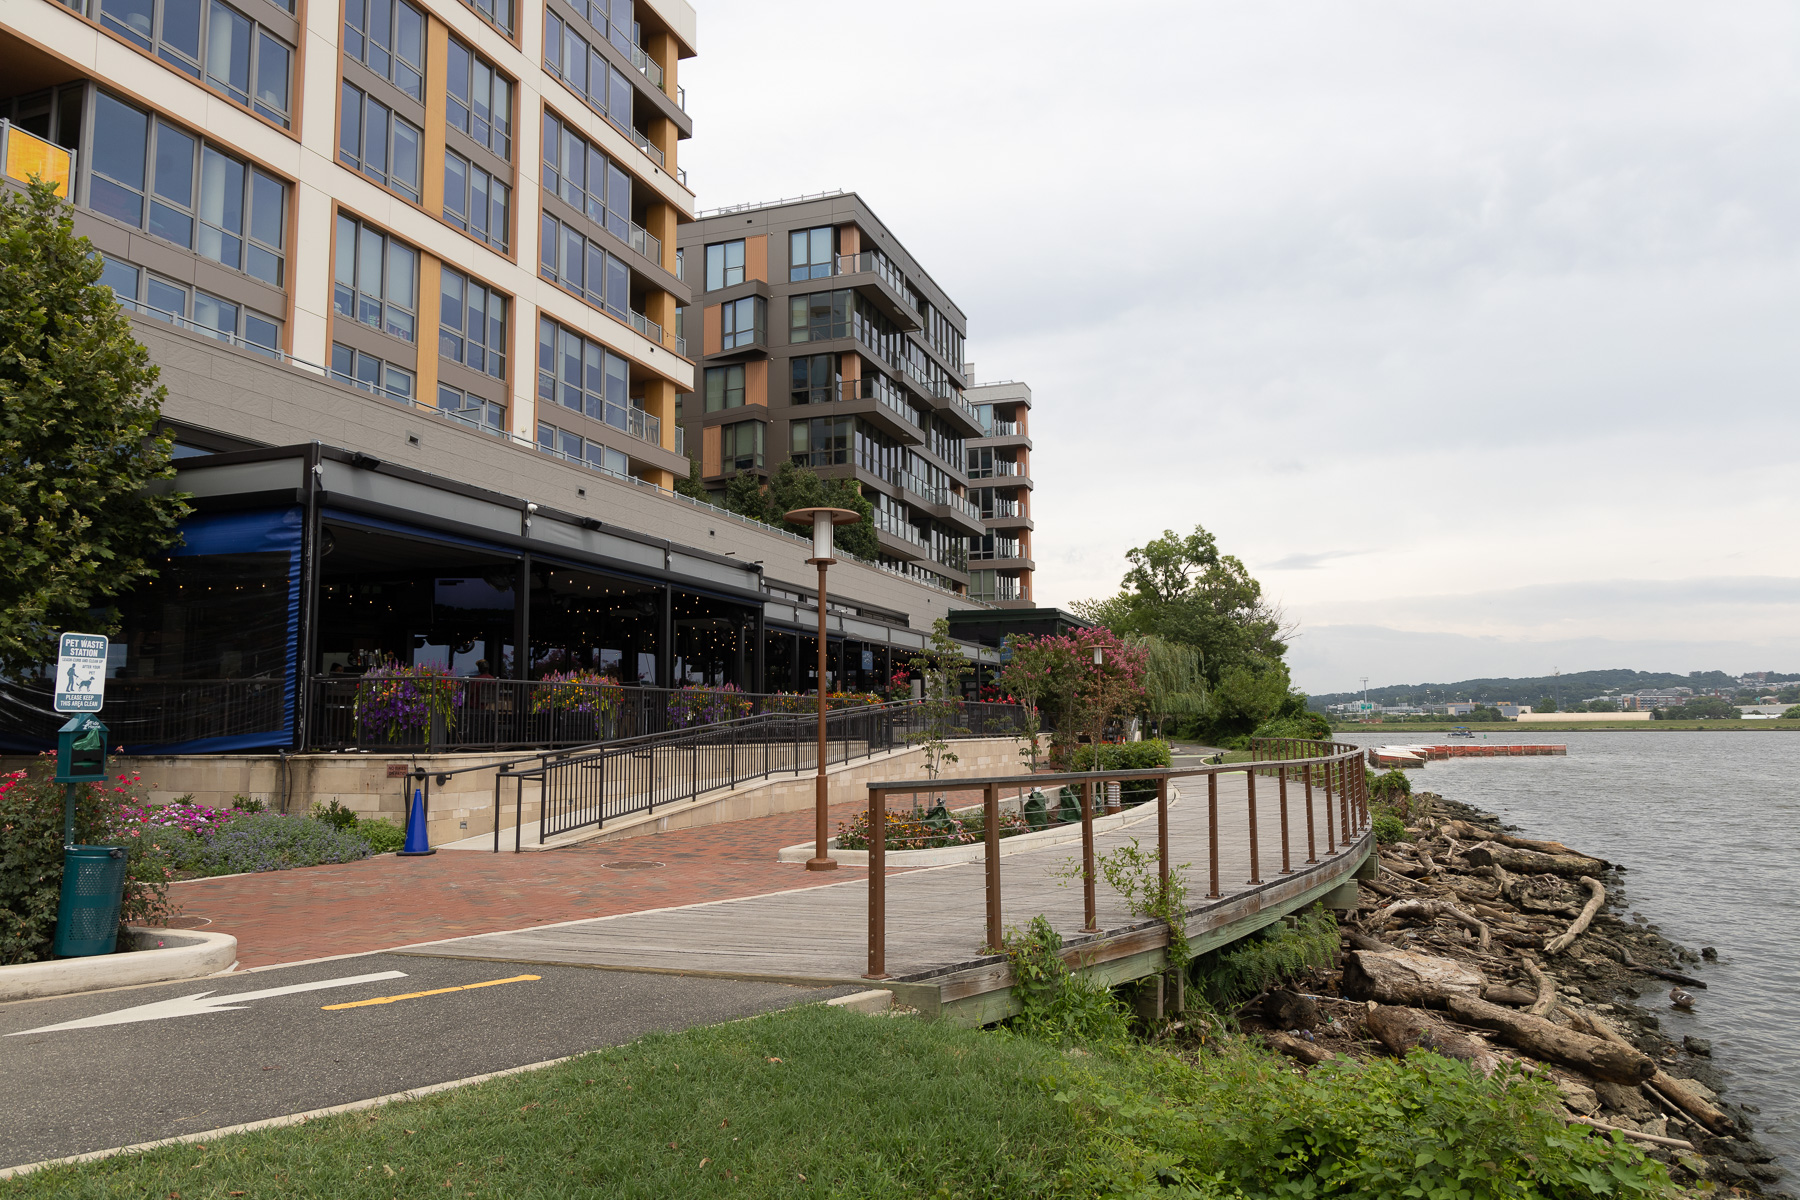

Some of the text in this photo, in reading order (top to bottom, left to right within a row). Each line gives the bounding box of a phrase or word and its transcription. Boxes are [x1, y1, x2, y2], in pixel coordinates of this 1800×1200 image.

[65, 639, 104, 649] PET WASTE
[70, 648, 98, 657] STATION
